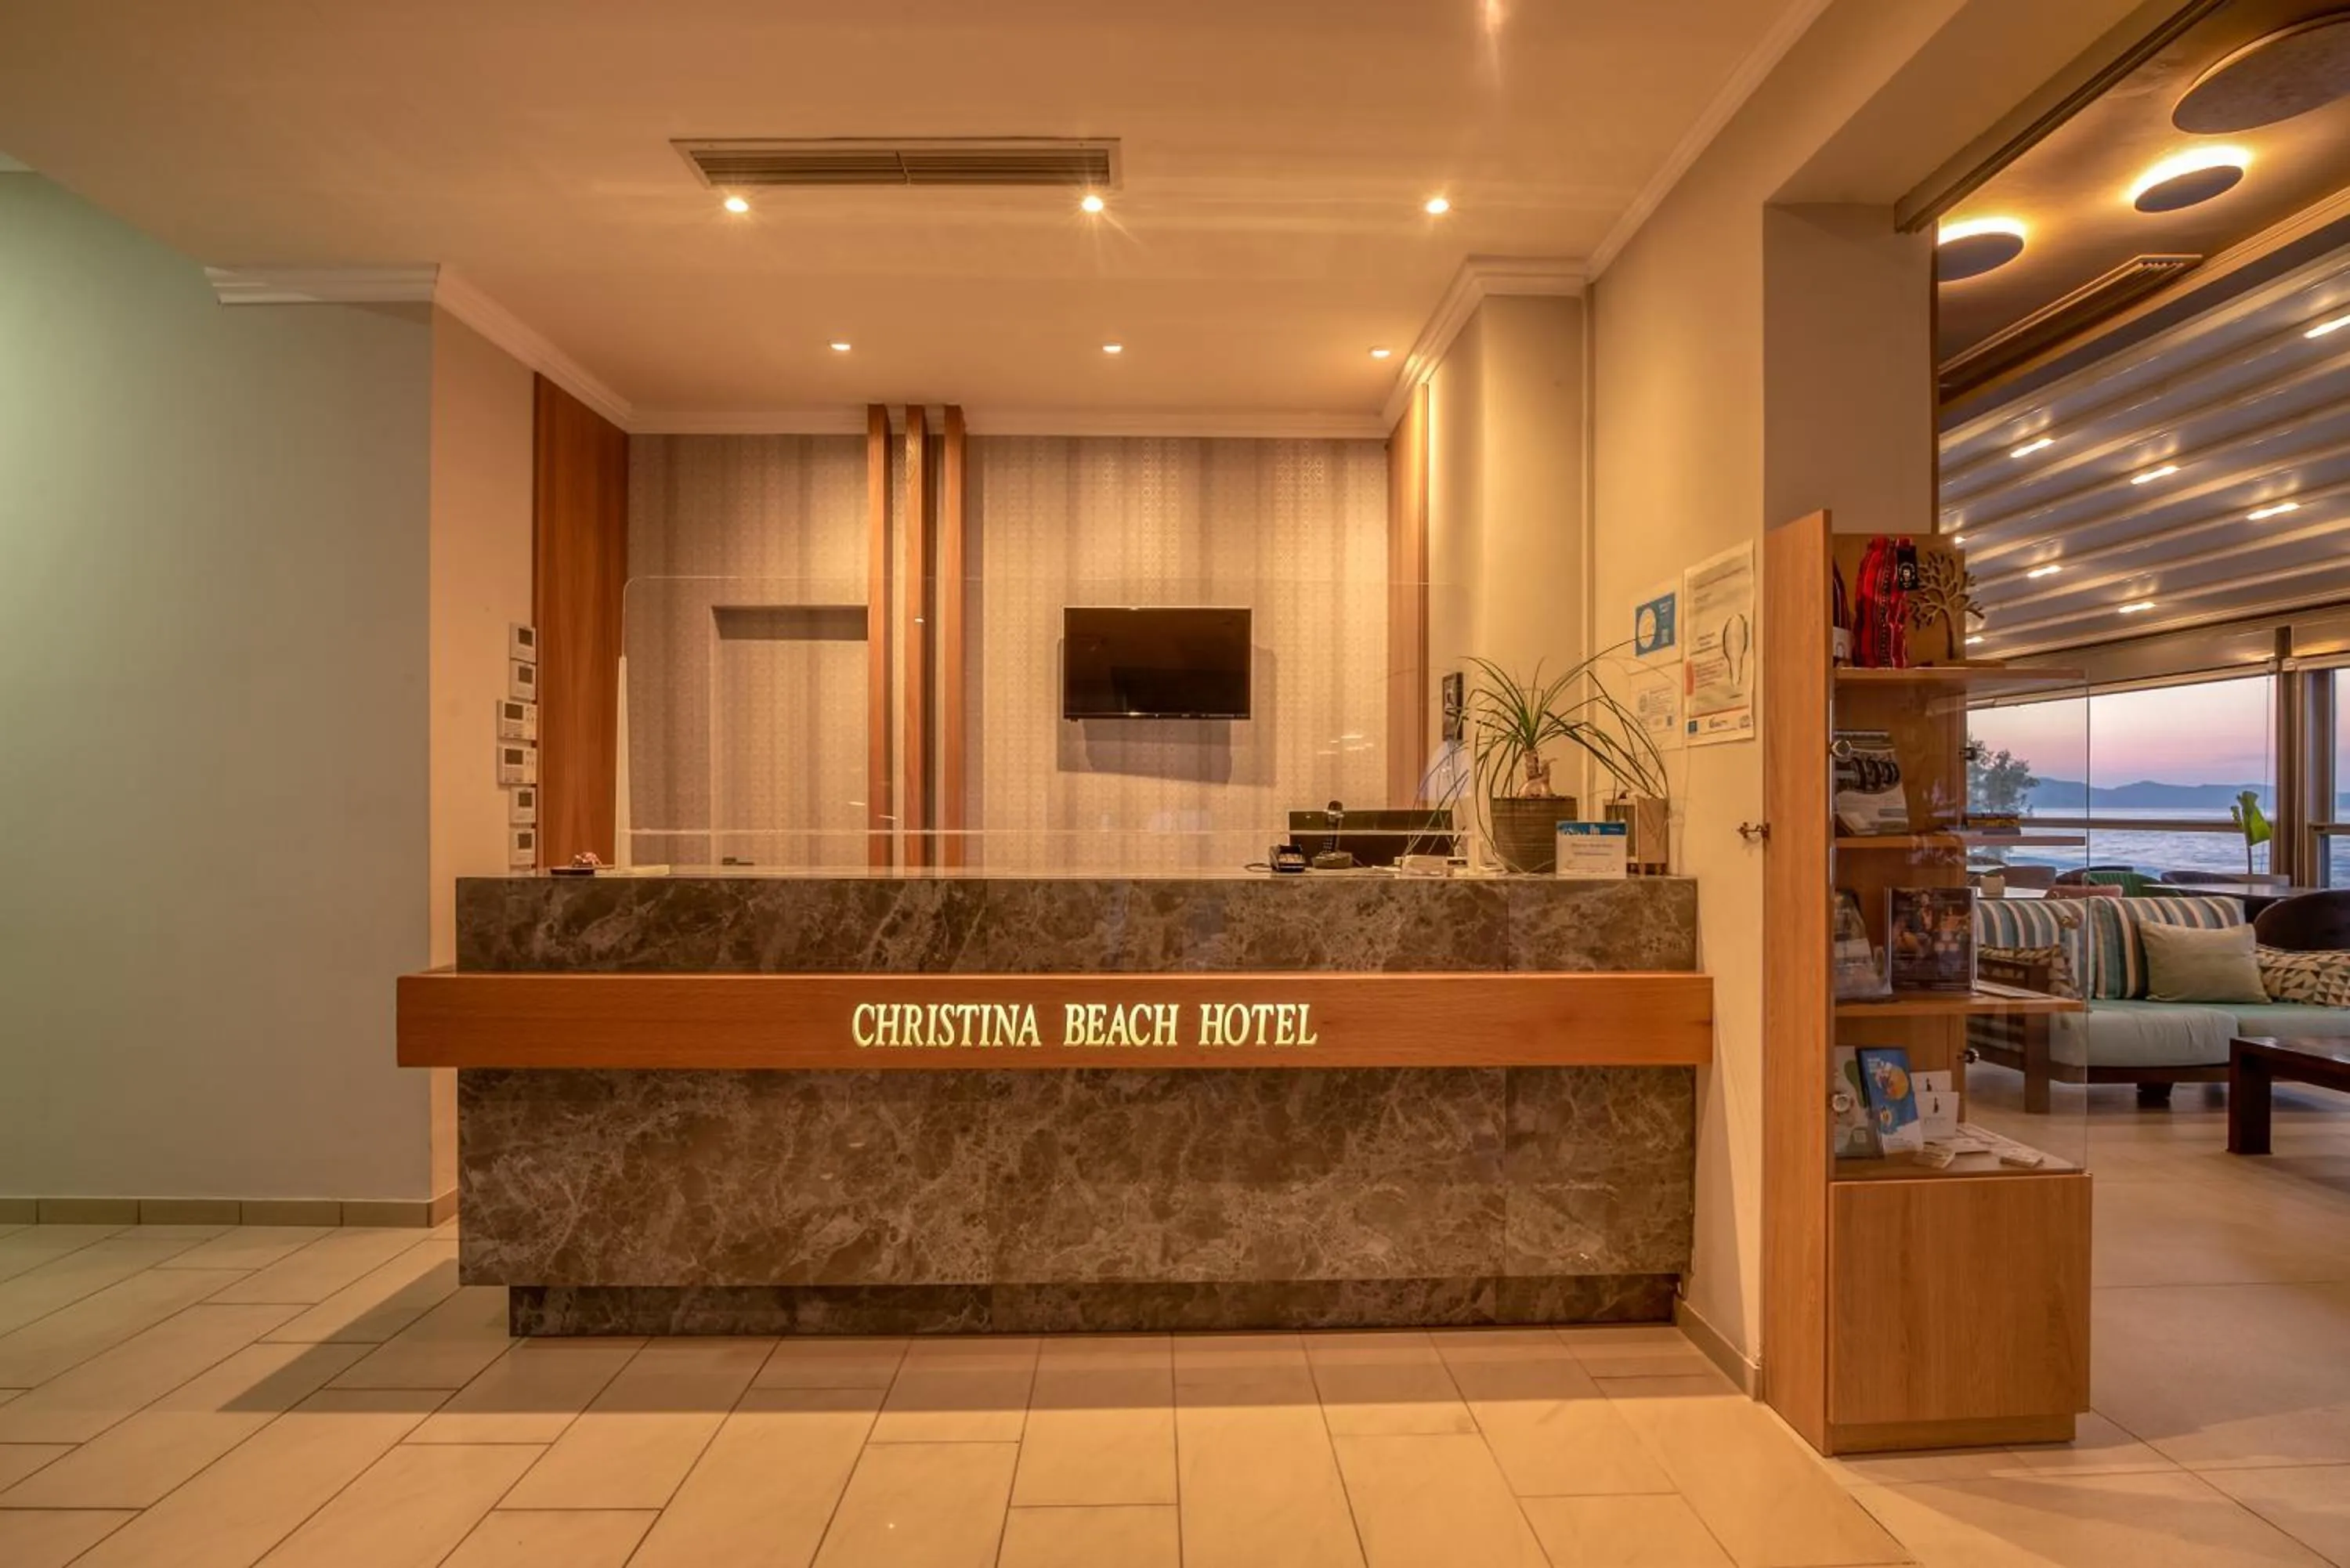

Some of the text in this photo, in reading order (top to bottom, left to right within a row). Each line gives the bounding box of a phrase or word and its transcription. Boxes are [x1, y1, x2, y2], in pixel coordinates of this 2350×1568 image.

[851, 1003, 1318, 1047] CHRISTINA BEACH HOTEL
